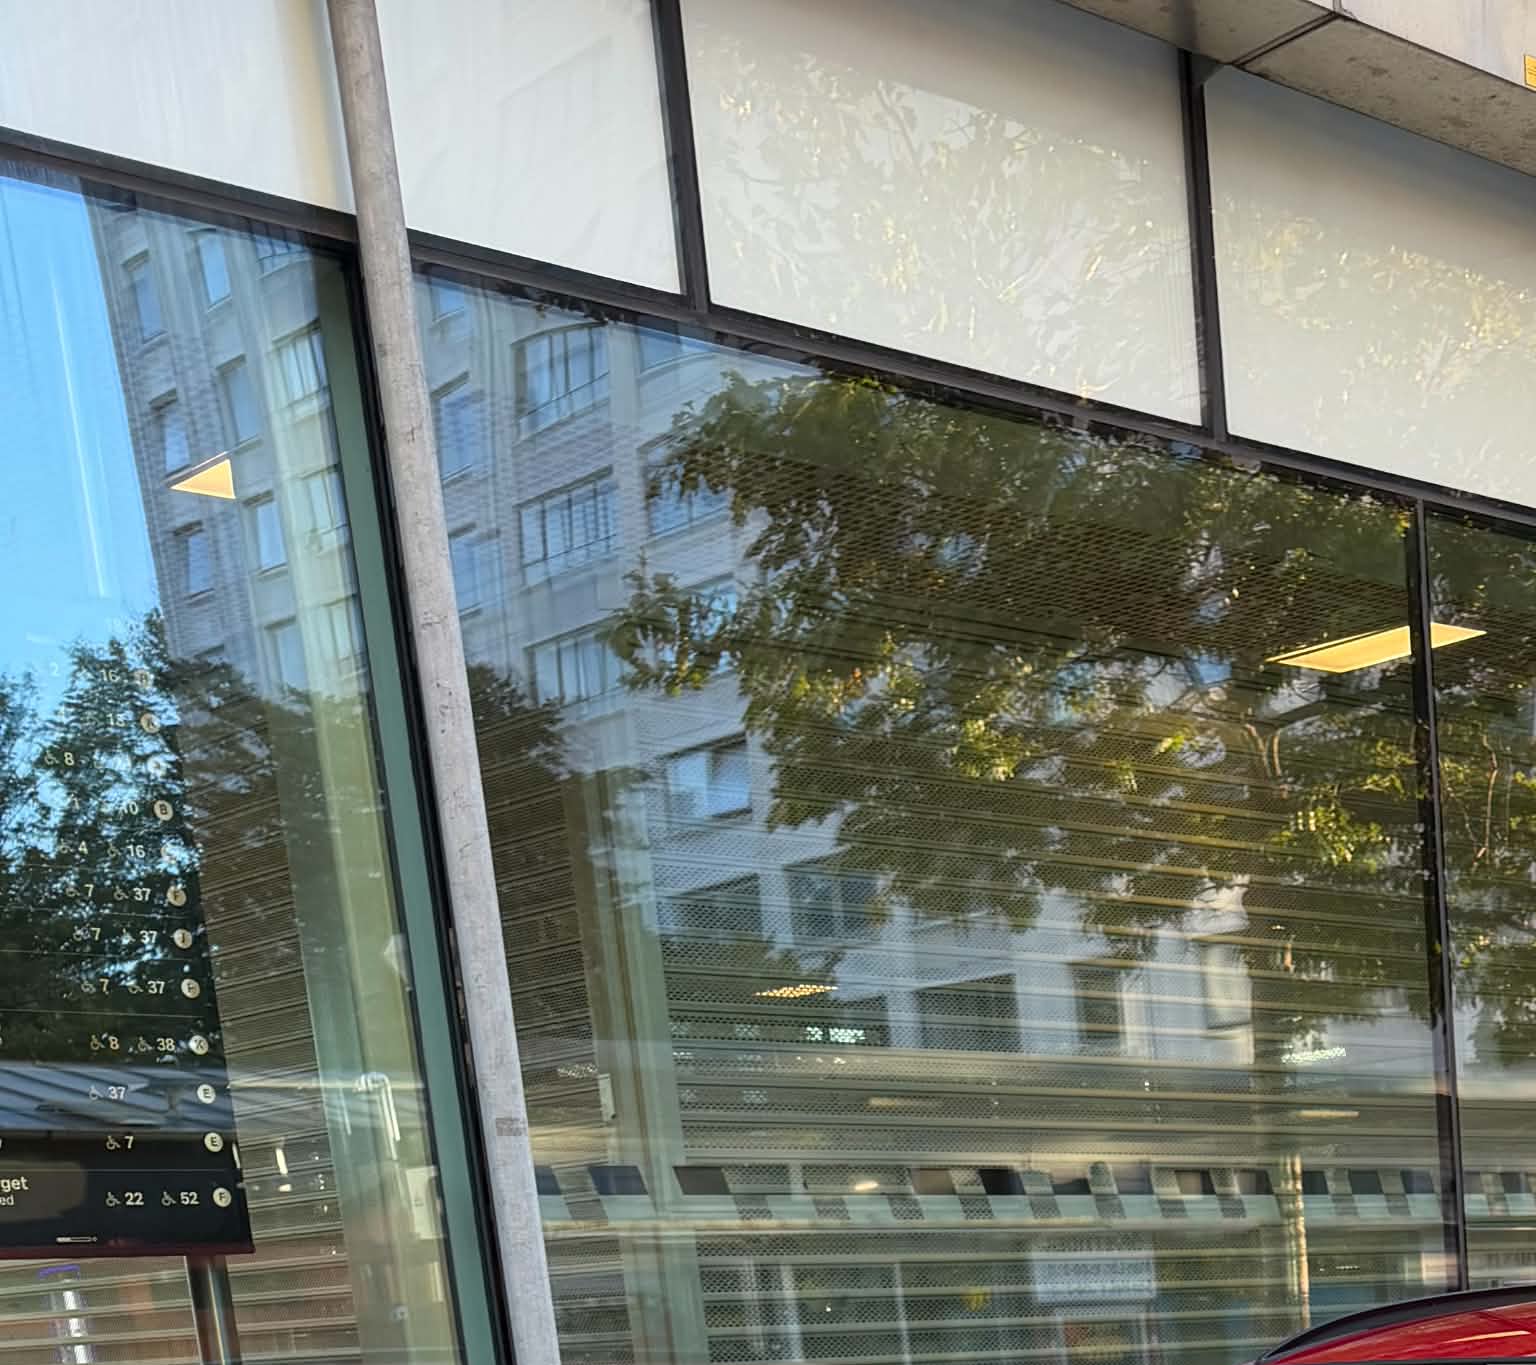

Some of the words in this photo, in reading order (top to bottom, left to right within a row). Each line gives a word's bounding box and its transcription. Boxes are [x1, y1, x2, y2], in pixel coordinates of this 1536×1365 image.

[63, 751, 75, 766] 8
[78, 840, 88, 855] 4
[127, 844, 145, 858] 16
[85, 883, 94, 897] 7
[133, 887, 151, 900] 37
[91, 927, 101, 941] 7
[139, 930, 158, 944] 37
[100, 978, 109, 992] 7
[147, 981, 165, 994] 37
[108, 1036, 120, 1050] 8
[156, 1037, 176, 1052] 38
[107, 1086, 126, 1100] 37
[124, 1135, 134, 1149] 7
[124, 1192, 144, 1206] 22
[180, 1191, 200, 1205] 52
